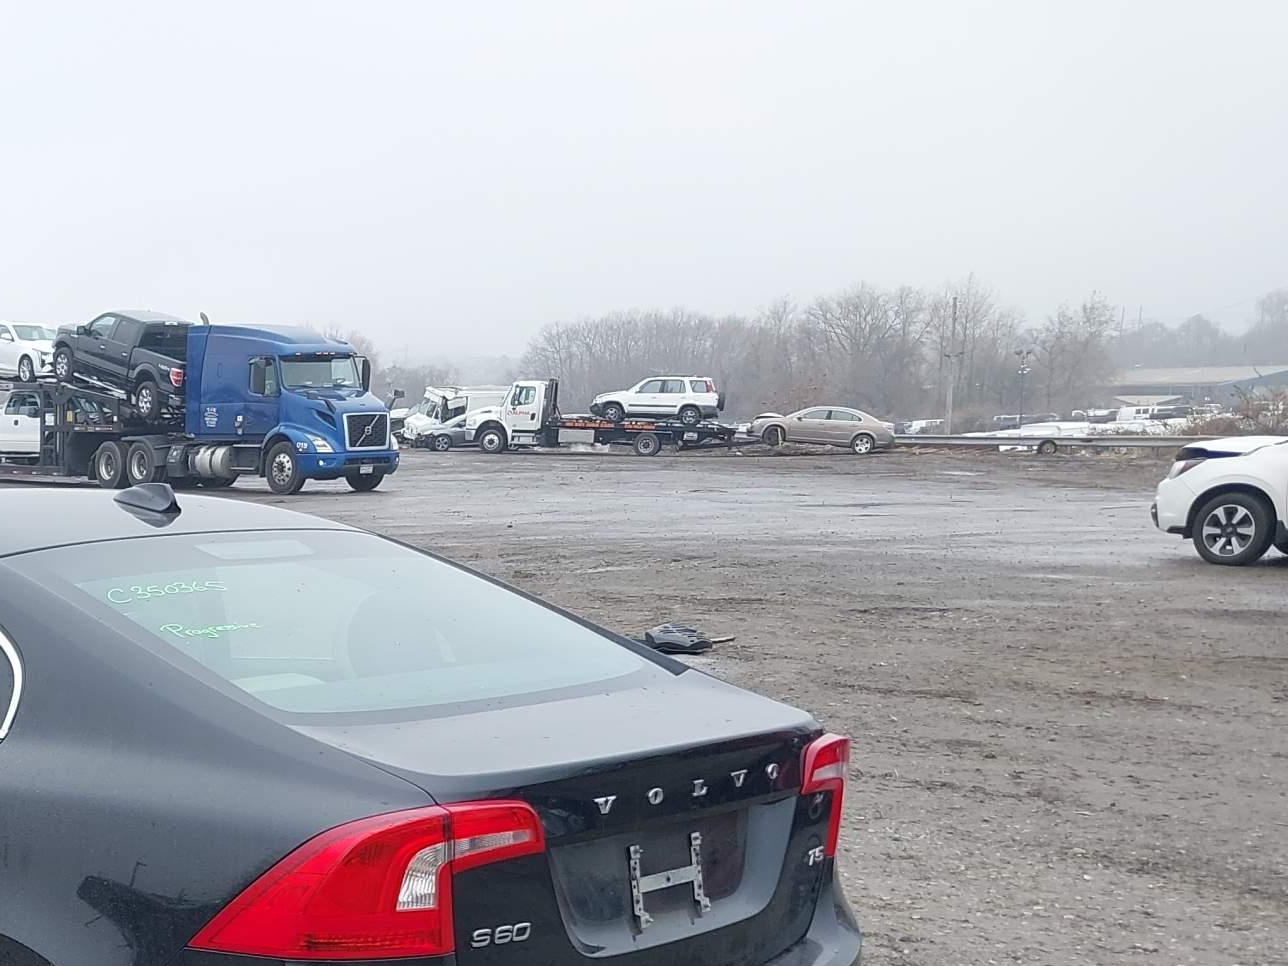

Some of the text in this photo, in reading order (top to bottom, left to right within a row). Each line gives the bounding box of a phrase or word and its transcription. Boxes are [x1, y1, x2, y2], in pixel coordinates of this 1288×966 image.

[592, 763, 780, 815] VOLVO
[808, 845, 825, 866] T5
[470, 922, 532, 949] S60
